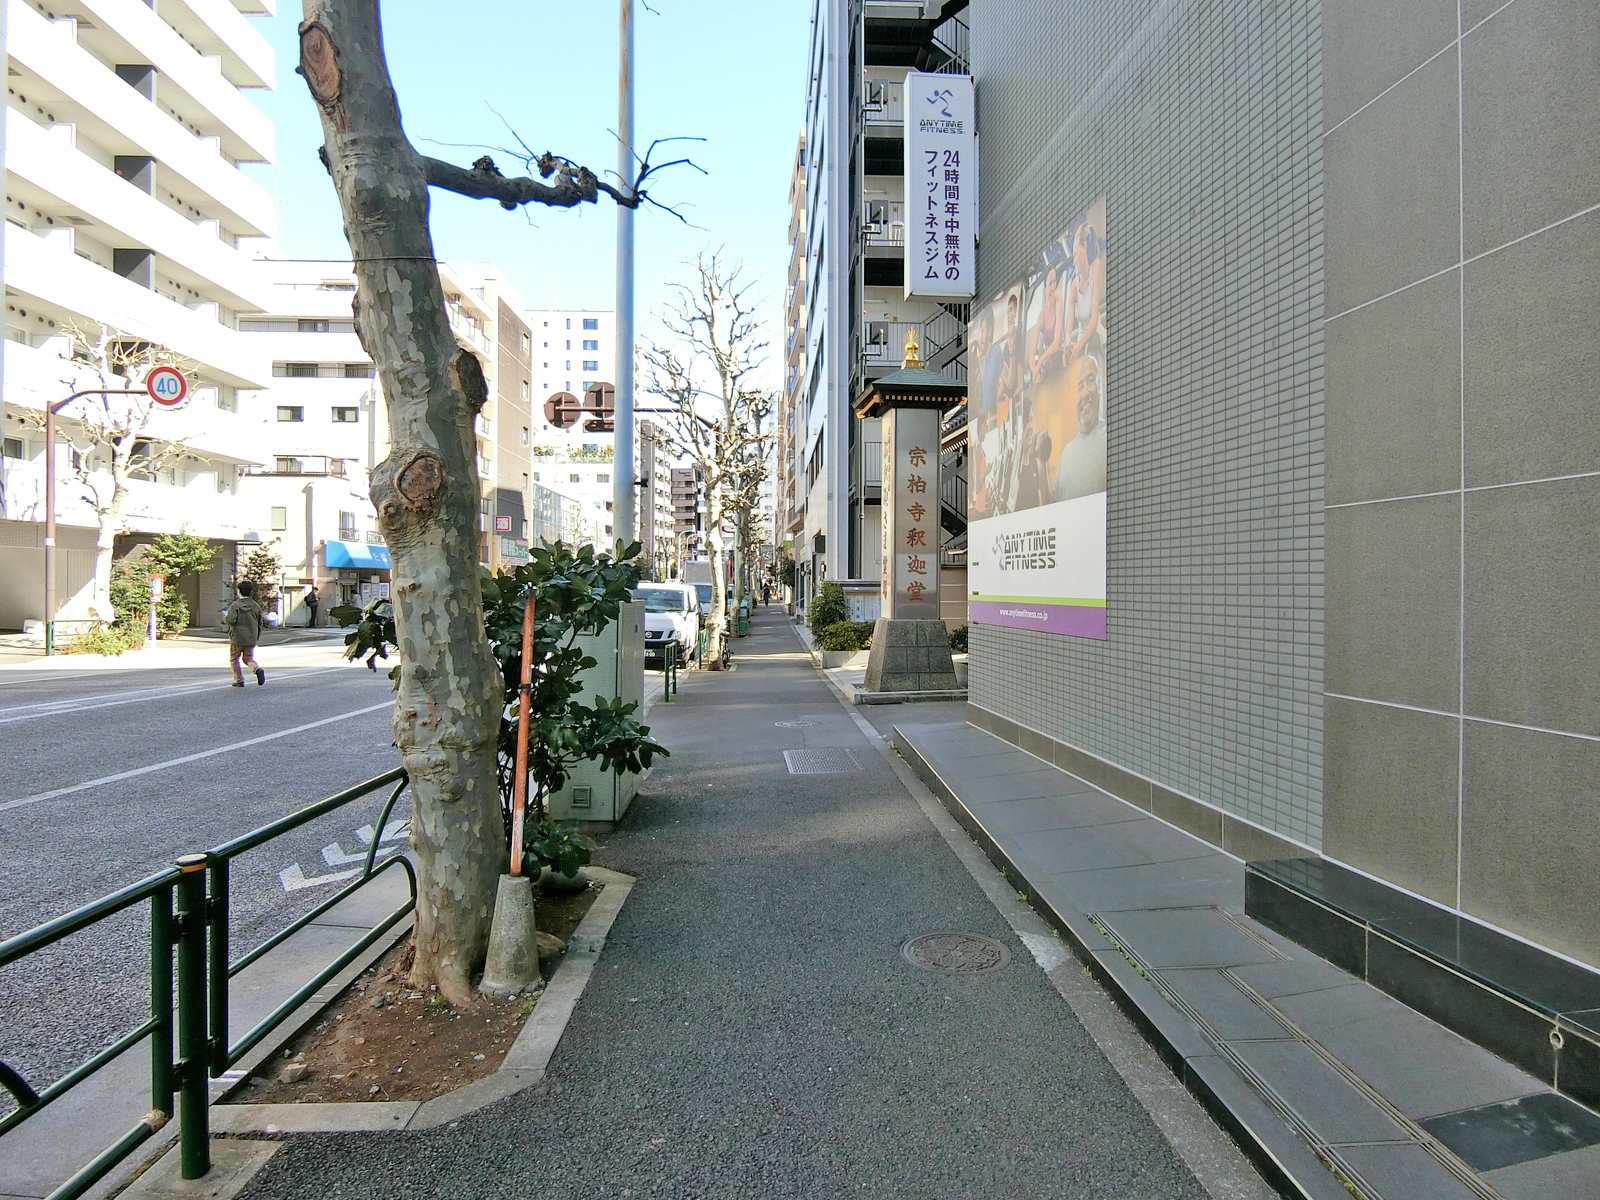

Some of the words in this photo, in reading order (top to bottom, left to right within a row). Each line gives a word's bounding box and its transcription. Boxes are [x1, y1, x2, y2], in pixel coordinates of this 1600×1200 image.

[920, 119, 963, 128] ANYTIME
[924, 150, 939, 279] フィットネスジム
[943, 150, 960, 281] 24時間年中無休の
[157, 378, 178, 395] 40
[907, 446, 928, 601] 宗柏寺釈迦堂
[1004, 527, 1056, 554] ANYTIME
[1004, 551, 1056, 571] FITNESS
